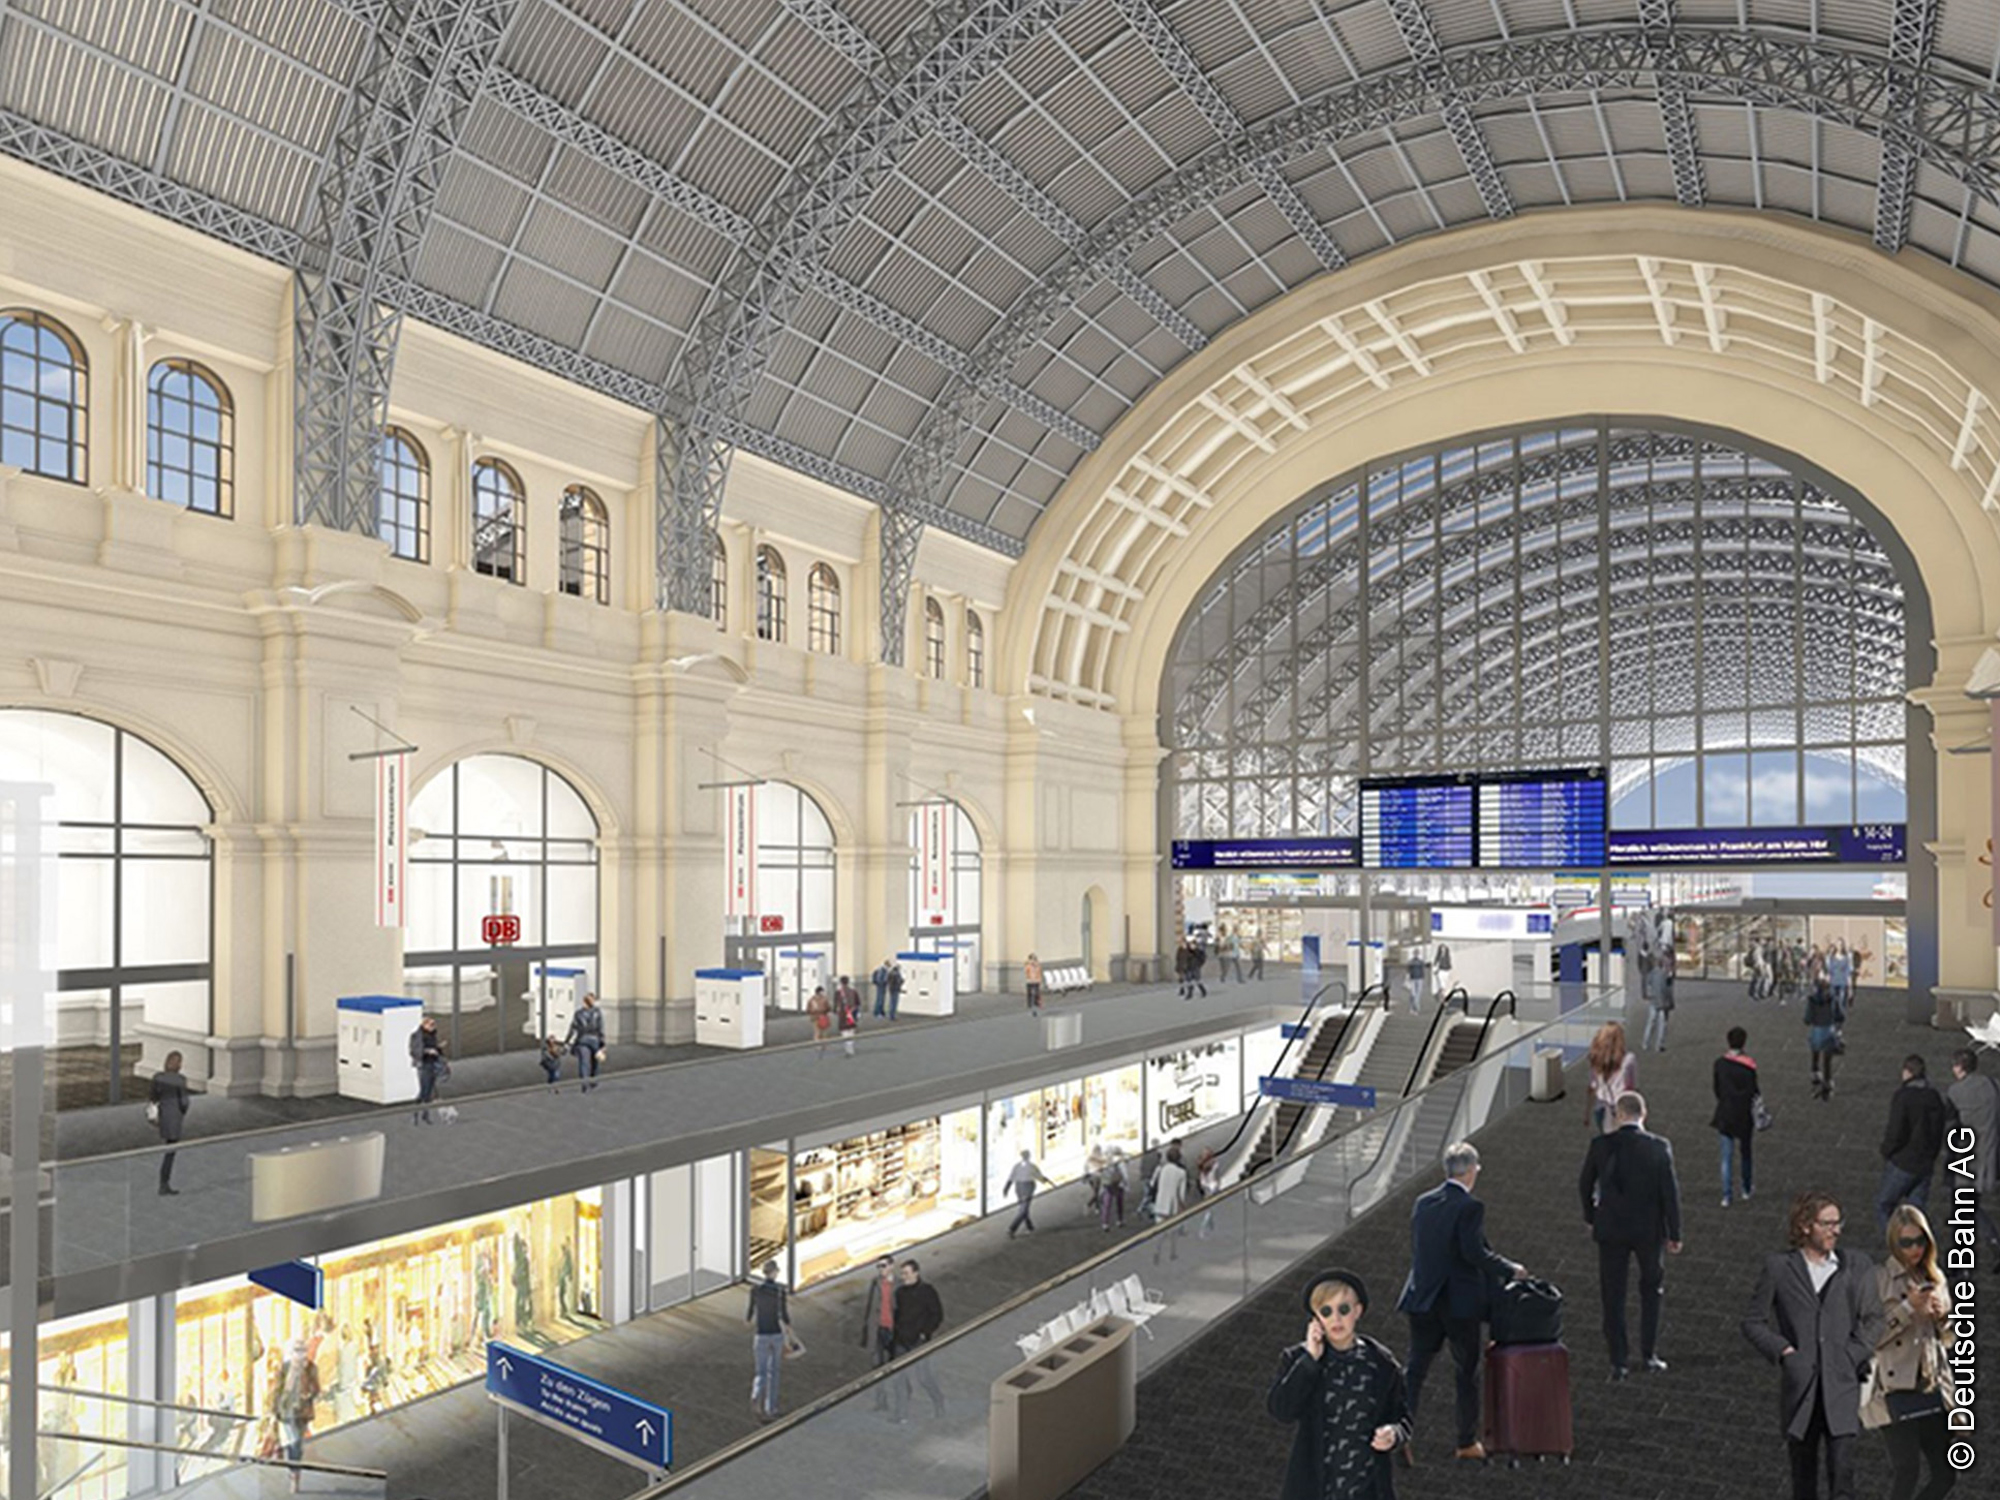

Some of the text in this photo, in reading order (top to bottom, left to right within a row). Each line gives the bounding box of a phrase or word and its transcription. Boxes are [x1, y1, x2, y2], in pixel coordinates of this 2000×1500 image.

[486, 918, 517, 940] DB
[539, 1373, 611, 1412] Zu den Zügen
